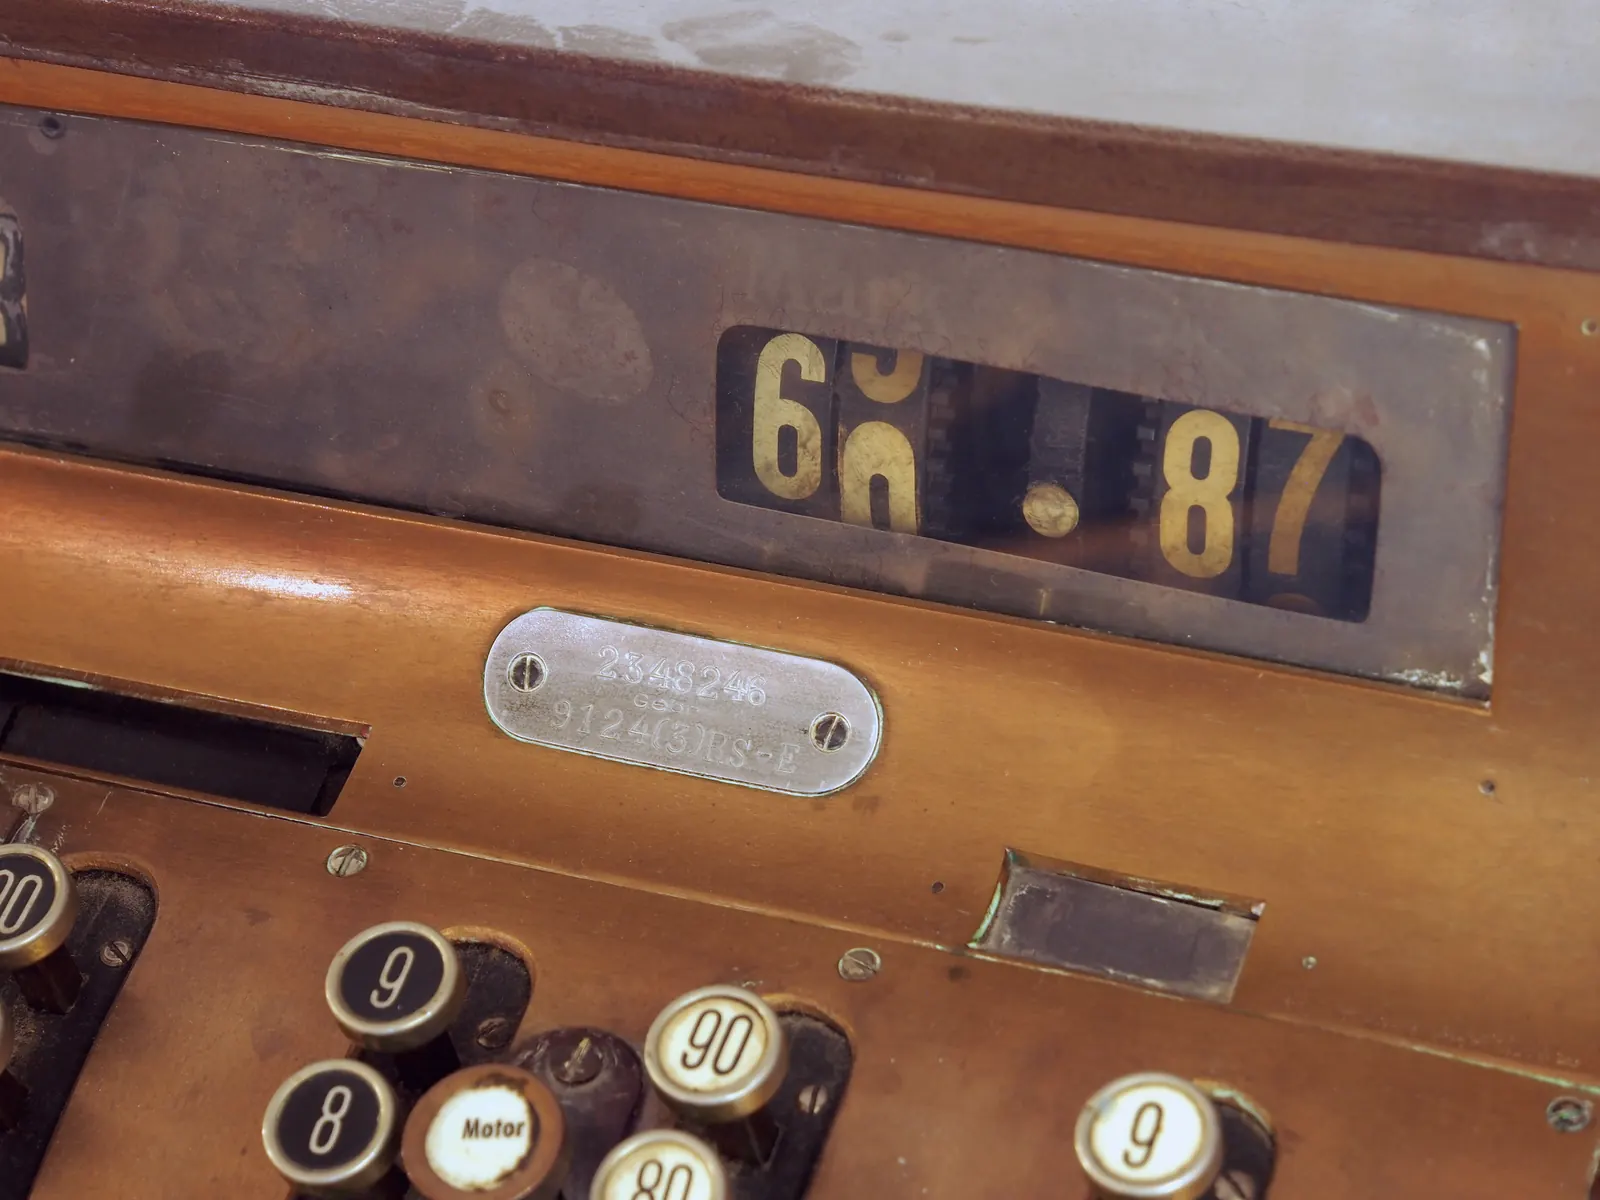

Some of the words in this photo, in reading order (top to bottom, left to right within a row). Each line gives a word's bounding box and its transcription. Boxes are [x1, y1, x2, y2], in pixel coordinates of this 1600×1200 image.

[596, 645, 767, 706] 2348246
[370, 946, 415, 1008] 9
[681, 1009, 754, 1075] 90
[308, 1084, 352, 1155] 8
[462, 1115, 526, 1141] Motor
[1123, 1101, 1164, 1168] 9
[631, 1158, 693, 1200] 80
